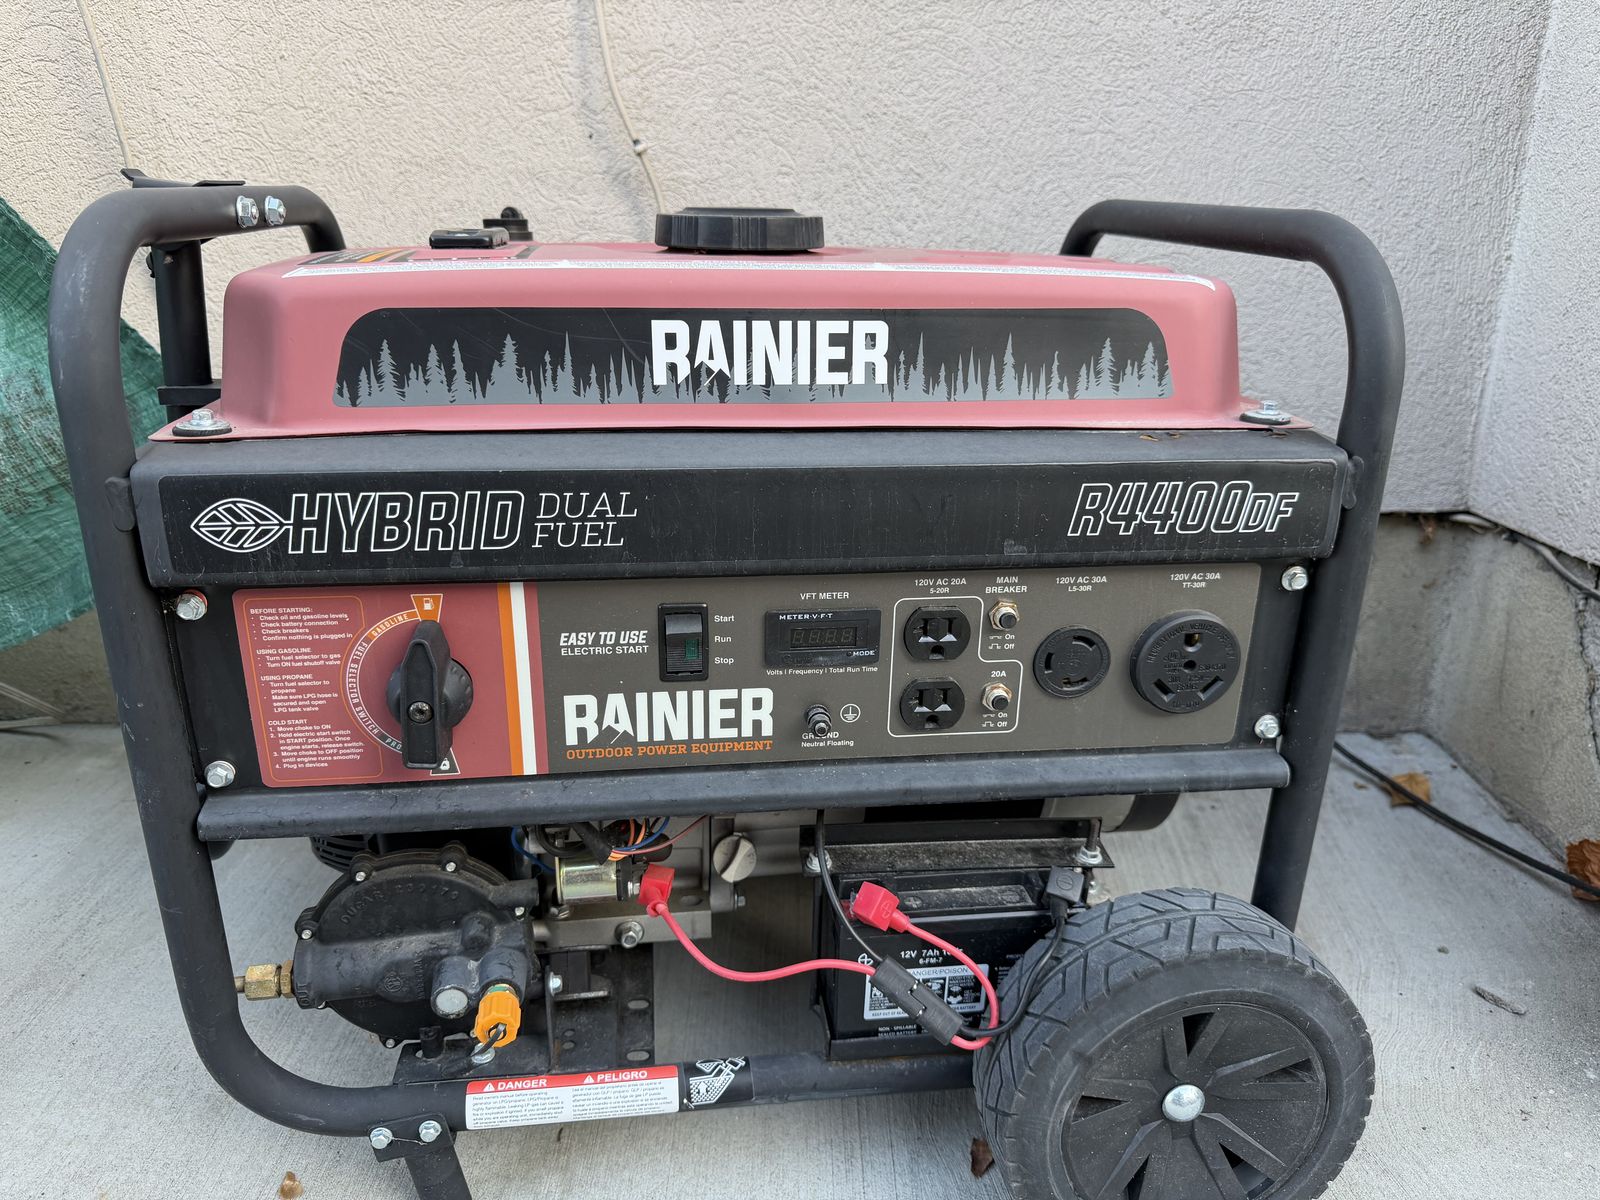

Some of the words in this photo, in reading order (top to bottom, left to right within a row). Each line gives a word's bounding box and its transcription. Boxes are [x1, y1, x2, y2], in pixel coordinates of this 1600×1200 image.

[652, 319, 889, 388] RAINIER
[540, 492, 637, 518] DUAL
[1069, 481, 1298, 536] R4400DF
[288, 491, 524, 553] HYBRID
[535, 522, 624, 547] FUEL
[372, 614, 409, 637] GASOLINE
[560, 632, 595, 646] EASY
[600, 632, 616, 644] TO
[620, 631, 648, 644] USE
[354, 642, 367, 660] FUEL
[562, 647, 612, 656] ELECTRIC
[616, 646, 649, 654] START
[349, 663, 360, 703] SELECTOR
[356, 705, 379, 733] SWITCH
[564, 688, 773, 745] RAINIER
[386, 738, 402, 750] PRO
[802, 732, 839, 740] GRND
[567, 747, 633, 759] OUTDOOR
[638, 744, 687, 756] POWER
[692, 740, 772, 753] EQUIPMENT
[922, 949, 939, 957] 7Ah
[912, 968, 968, 976] ANGER/POISON
[498, 1080, 547, 1090] DANGER
[597, 1070, 647, 1082] PELIGRO
